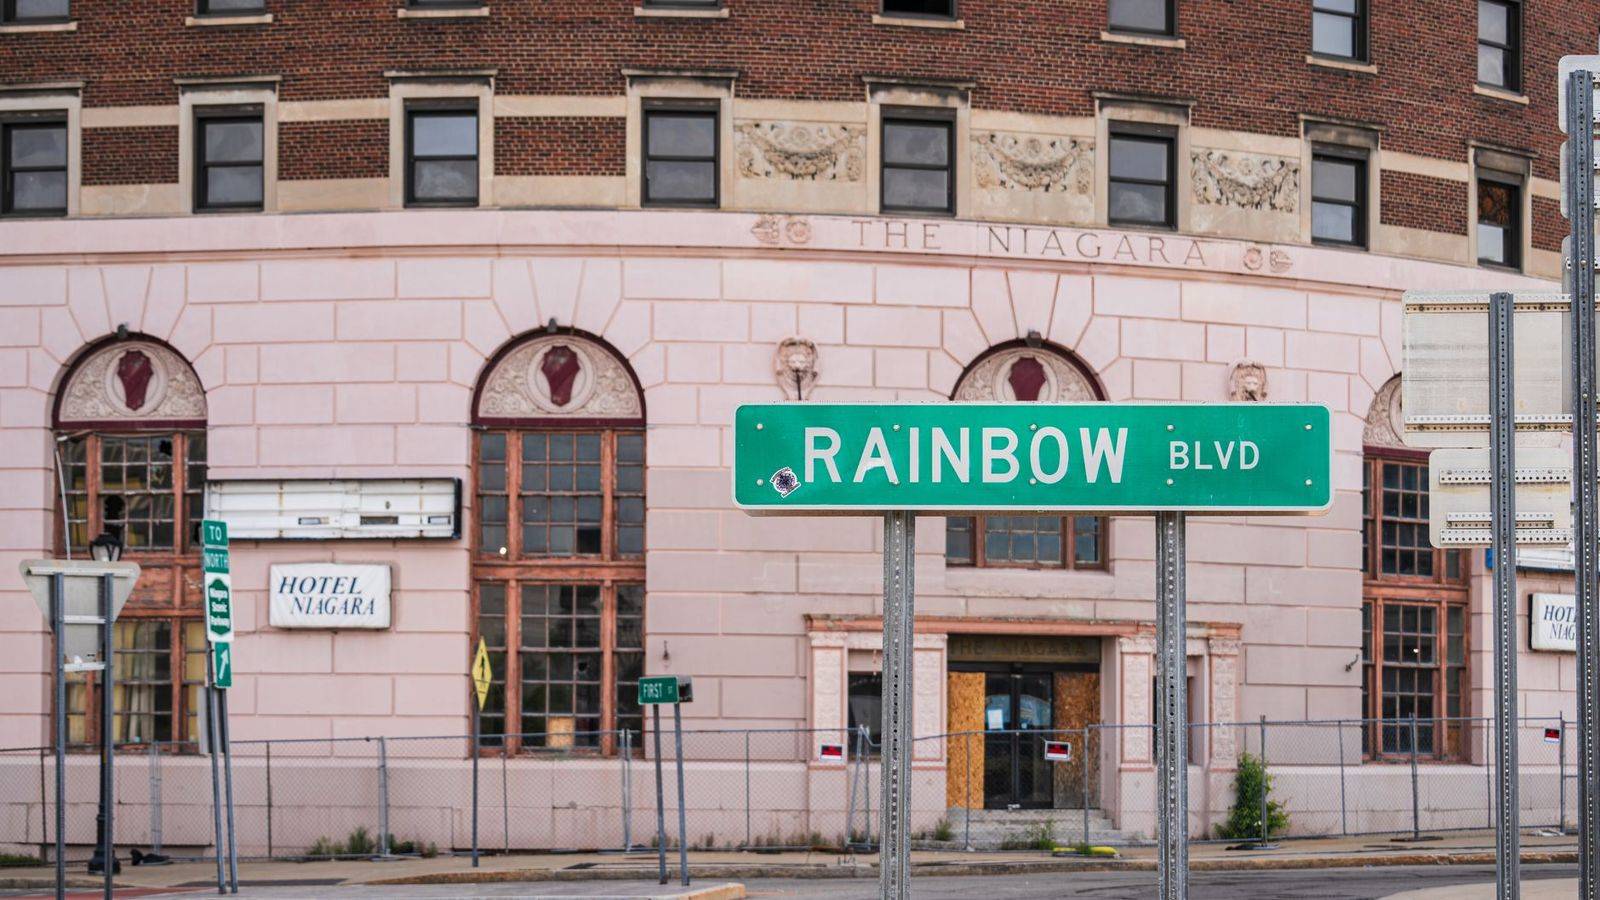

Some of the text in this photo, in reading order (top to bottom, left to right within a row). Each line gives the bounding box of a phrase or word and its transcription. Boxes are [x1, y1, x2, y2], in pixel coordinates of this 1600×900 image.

[852, 220, 1207, 267] THE NIAGARA
[804, 426, 1129, 485] RAINBOW
[1169, 440, 1261, 471] BLVD
[209, 525, 222, 541] TO
[205, 552, 229, 568] NORTH
[278, 576, 363, 594] HOTEL
[289, 596, 376, 616] NIAGARA
[1544, 605, 1577, 623] HOT
[1549, 622, 1577, 641] NIAG
[643, 682, 663, 699] FIRST
